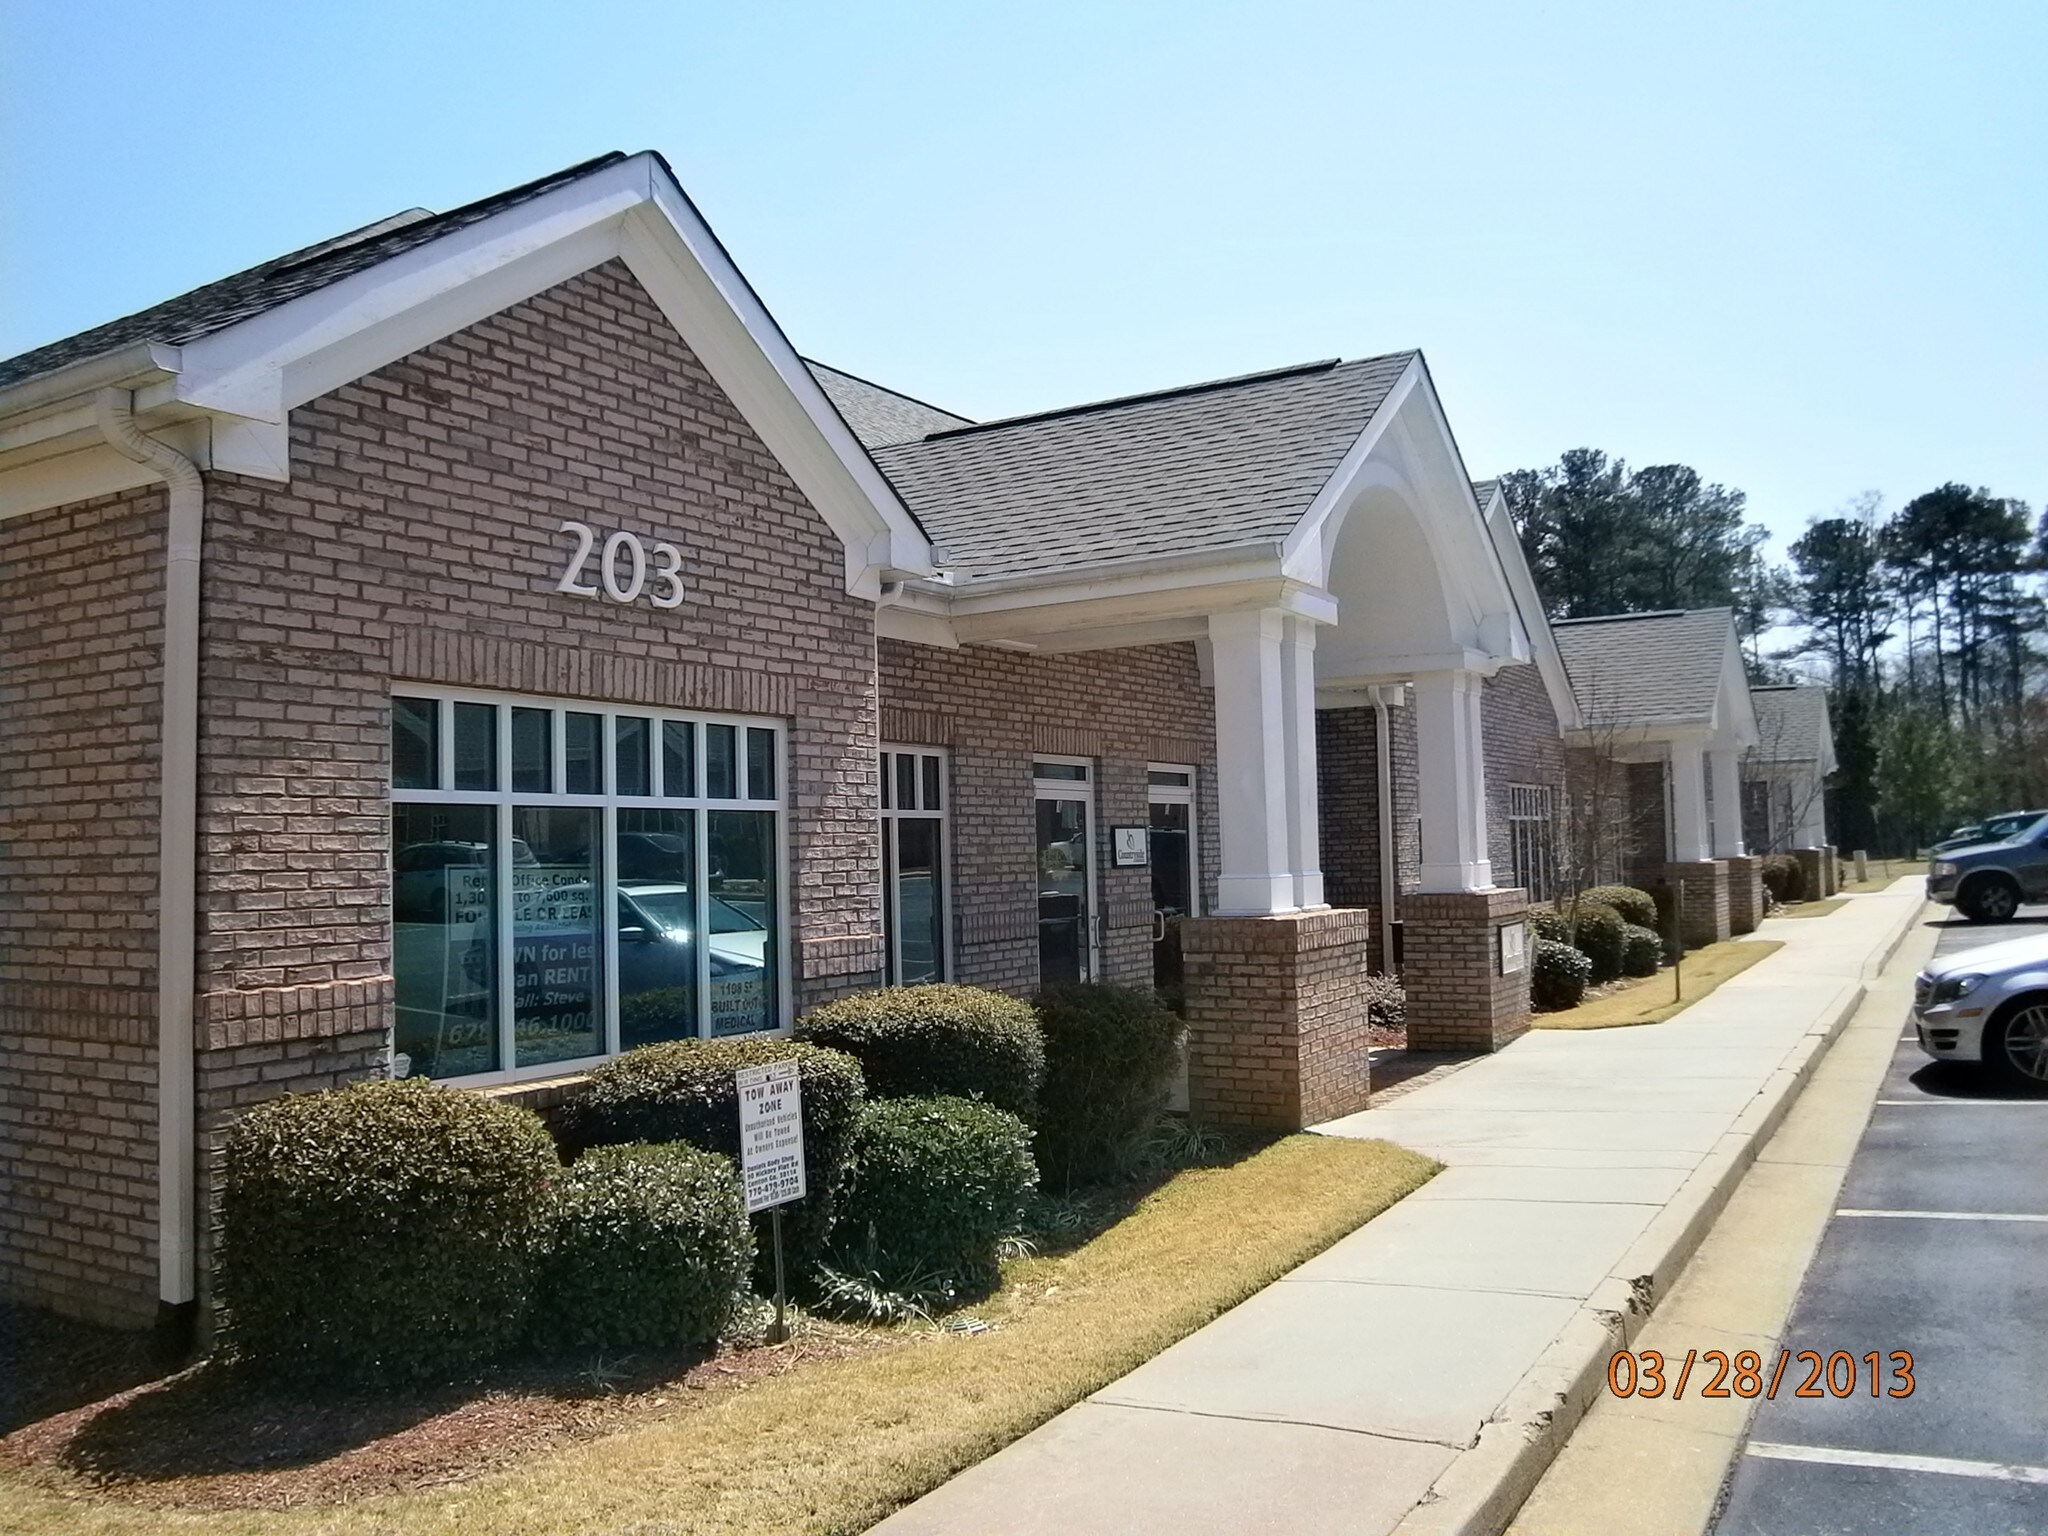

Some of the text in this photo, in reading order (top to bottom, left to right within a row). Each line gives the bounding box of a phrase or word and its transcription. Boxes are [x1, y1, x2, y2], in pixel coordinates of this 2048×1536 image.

[556, 521, 685, 609] 203
[518, 892, 531, 903] to
[542, 943, 567, 962] for
[543, 991, 585, 1007] Steve
[711, 999, 741, 1013] BUILT
[715, 1014, 756, 1030] MEDICAL
[738, 1066, 773, 1079] RESTRICTED
[745, 1080, 794, 1102] TOW AWAY
[759, 1099, 782, 1115] ZONE
